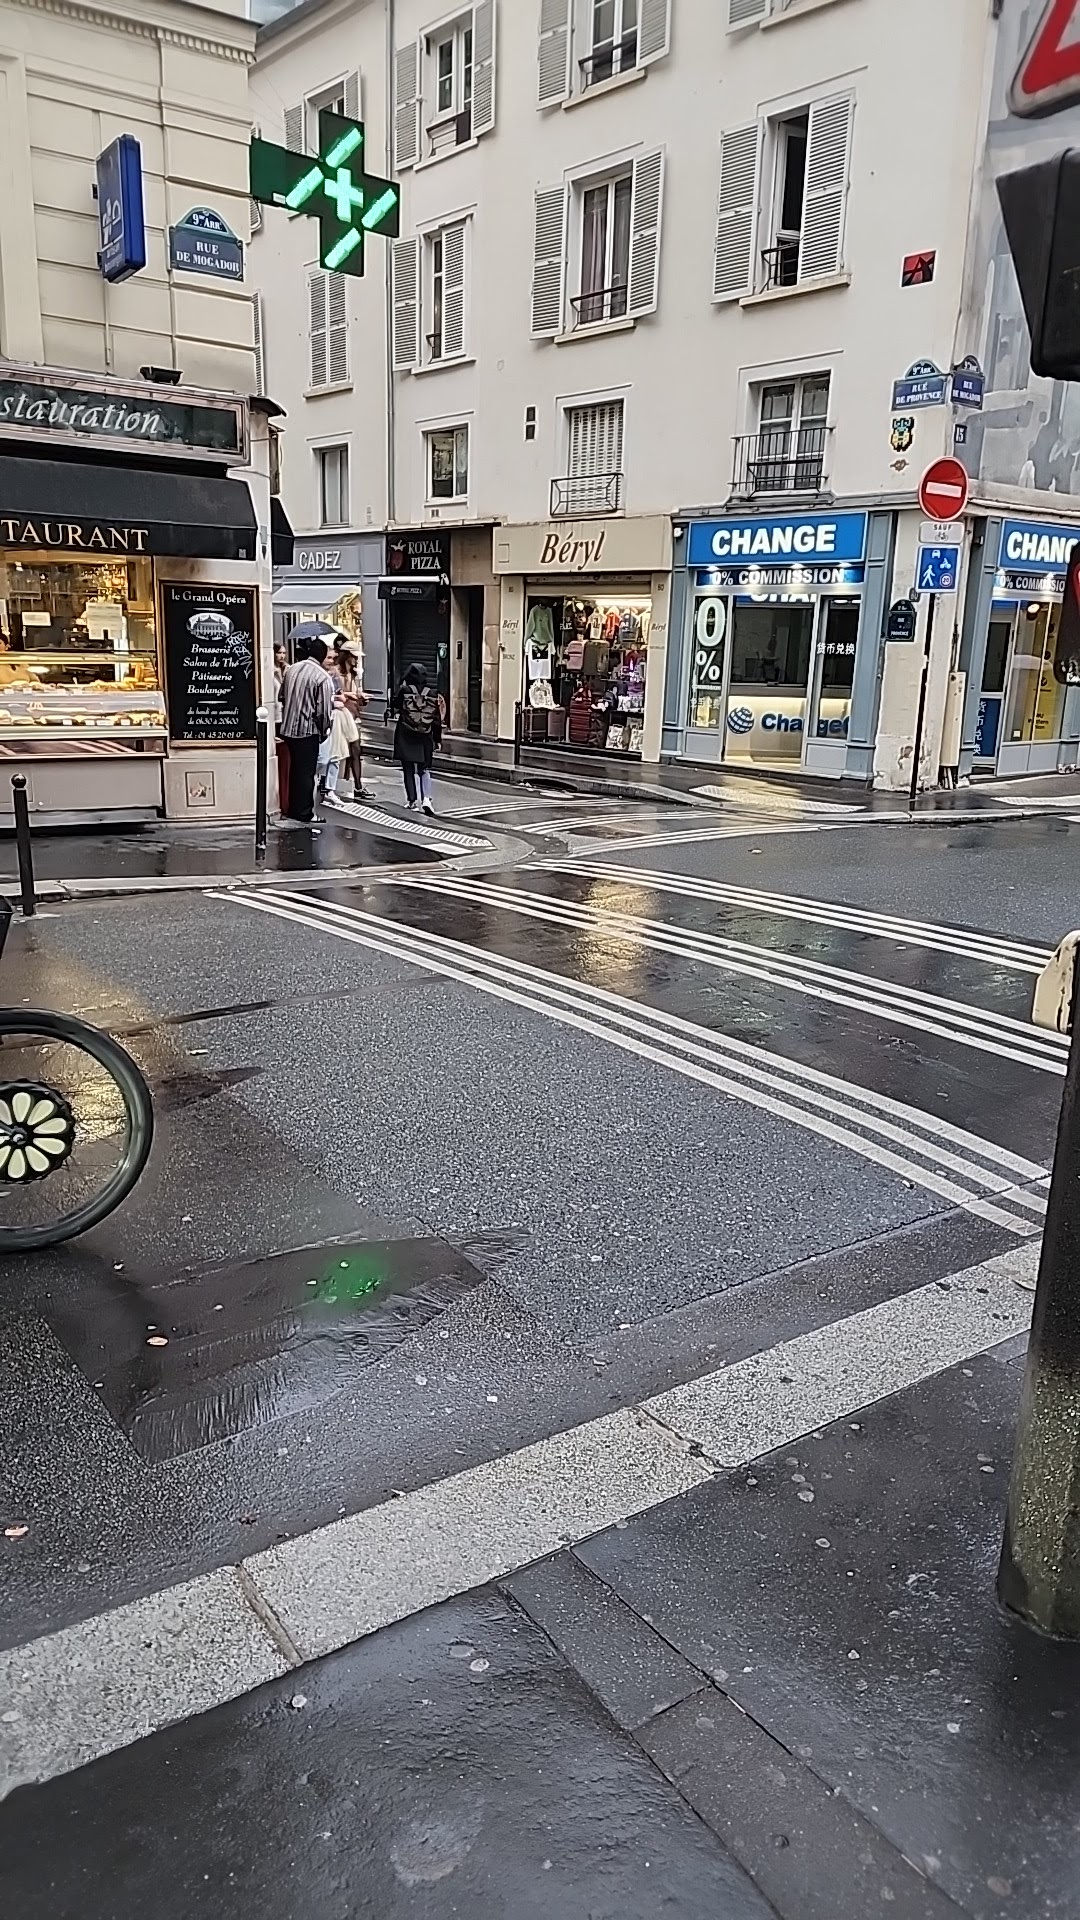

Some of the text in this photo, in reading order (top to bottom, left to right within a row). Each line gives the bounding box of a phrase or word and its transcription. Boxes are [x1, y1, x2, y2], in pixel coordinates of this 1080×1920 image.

[196, 241, 219, 255] RUE
[176, 251, 240, 272] DE MOGADOR
[911, 381, 928, 393] RUE
[895, 391, 942, 405] DE PROVENCE
[0, 393, 161, 434] stauration
[955, 427, 965, 442] 15
[0, 519, 149, 550] TAURANT
[933, 523, 952, 531] SAUF
[408, 540, 443, 555] ROYAL
[712, 524, 838, 556] CHANGE
[540, 531, 606, 571] Béryl
[299, 551, 341, 571] CADEZ
[411, 557, 442, 570] PIZZA
[738, 568, 845, 586] COMMISSION
[171, 588, 247, 606] le Grand Opéra
[816, 641, 855, 656] 货币兑换
[183, 655, 208, 667] Salon
[209, 656, 221, 668] de
